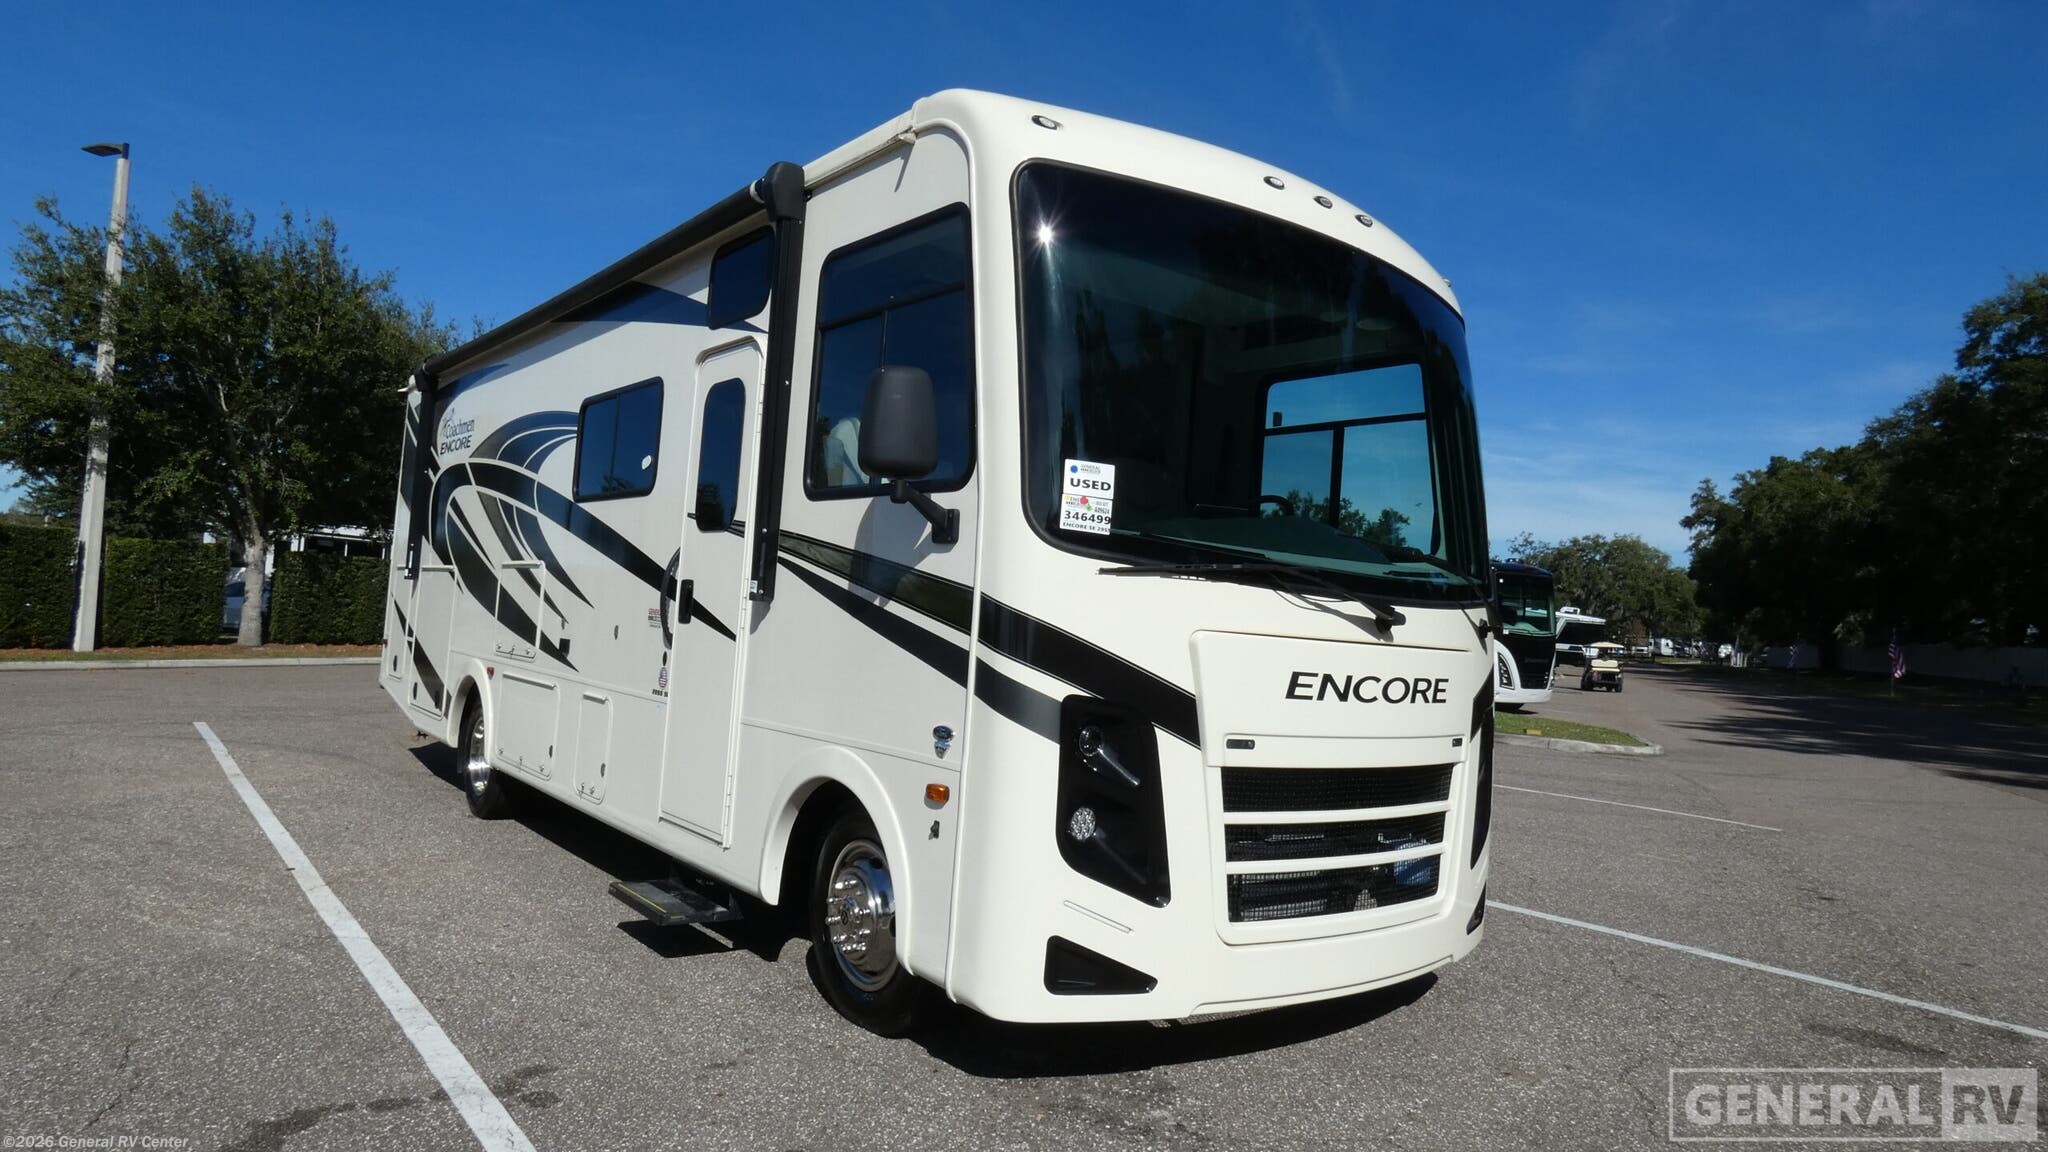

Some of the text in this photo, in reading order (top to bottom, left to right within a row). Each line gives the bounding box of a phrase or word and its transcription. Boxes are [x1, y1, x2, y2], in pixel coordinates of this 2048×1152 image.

[440, 435, 472, 455] ENCORE
[1070, 478, 1111, 491] USED
[1064, 511, 1111, 525] 346499
[1063, 522, 1087, 530] ENCORE
[1285, 671, 1449, 704] ENCORE
